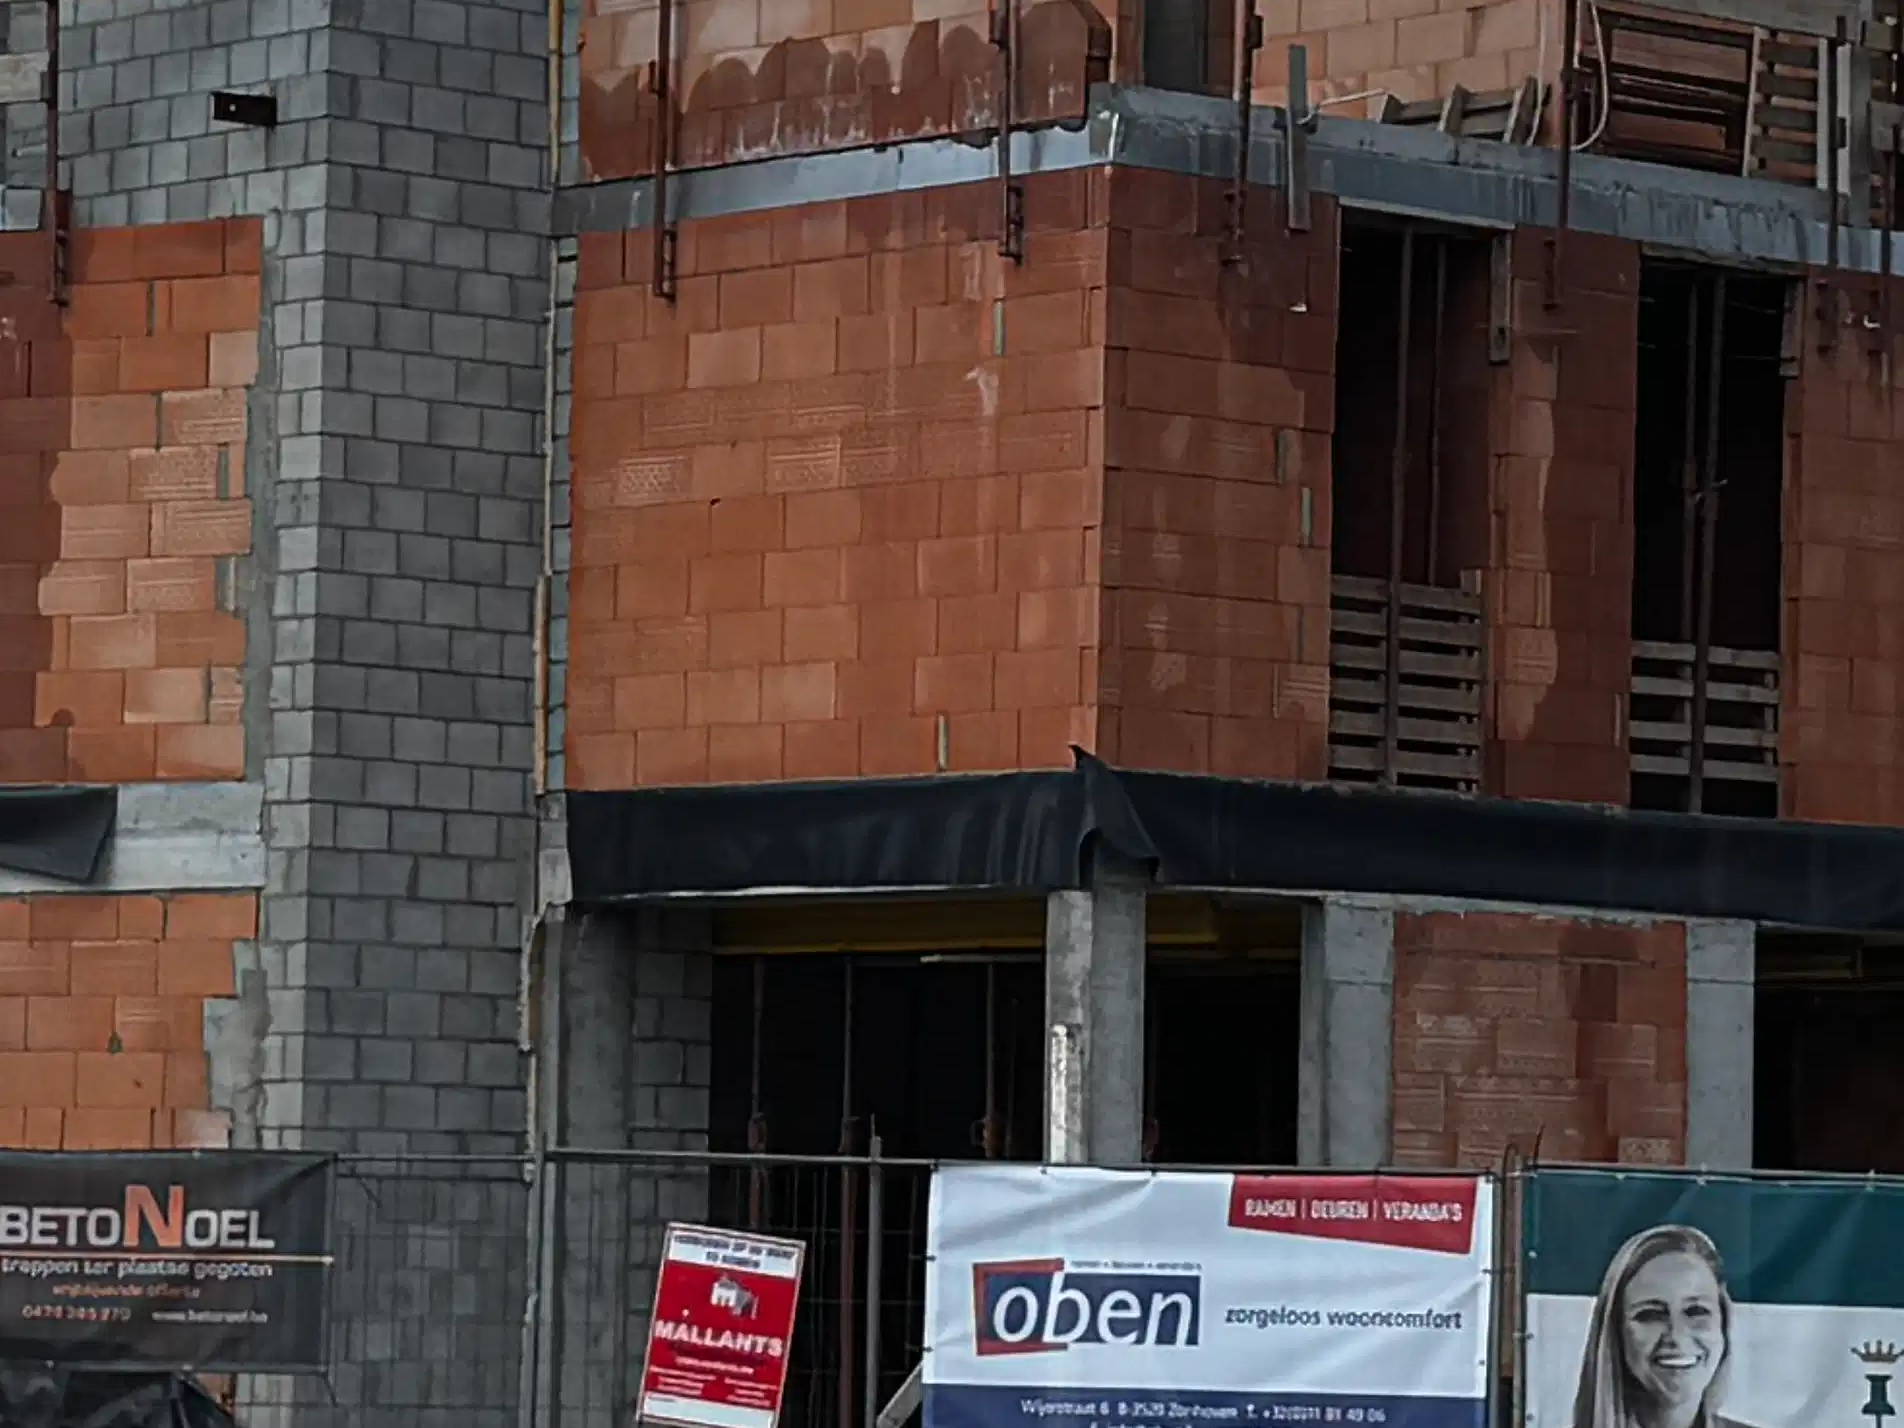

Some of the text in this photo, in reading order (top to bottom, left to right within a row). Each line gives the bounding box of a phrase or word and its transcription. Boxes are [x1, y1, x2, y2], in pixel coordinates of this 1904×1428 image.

[993, 1270, 1193, 1346] oben
[1225, 1305, 1321, 1330] zorgeloos
[655, 1319, 783, 1357] MALLANTS
